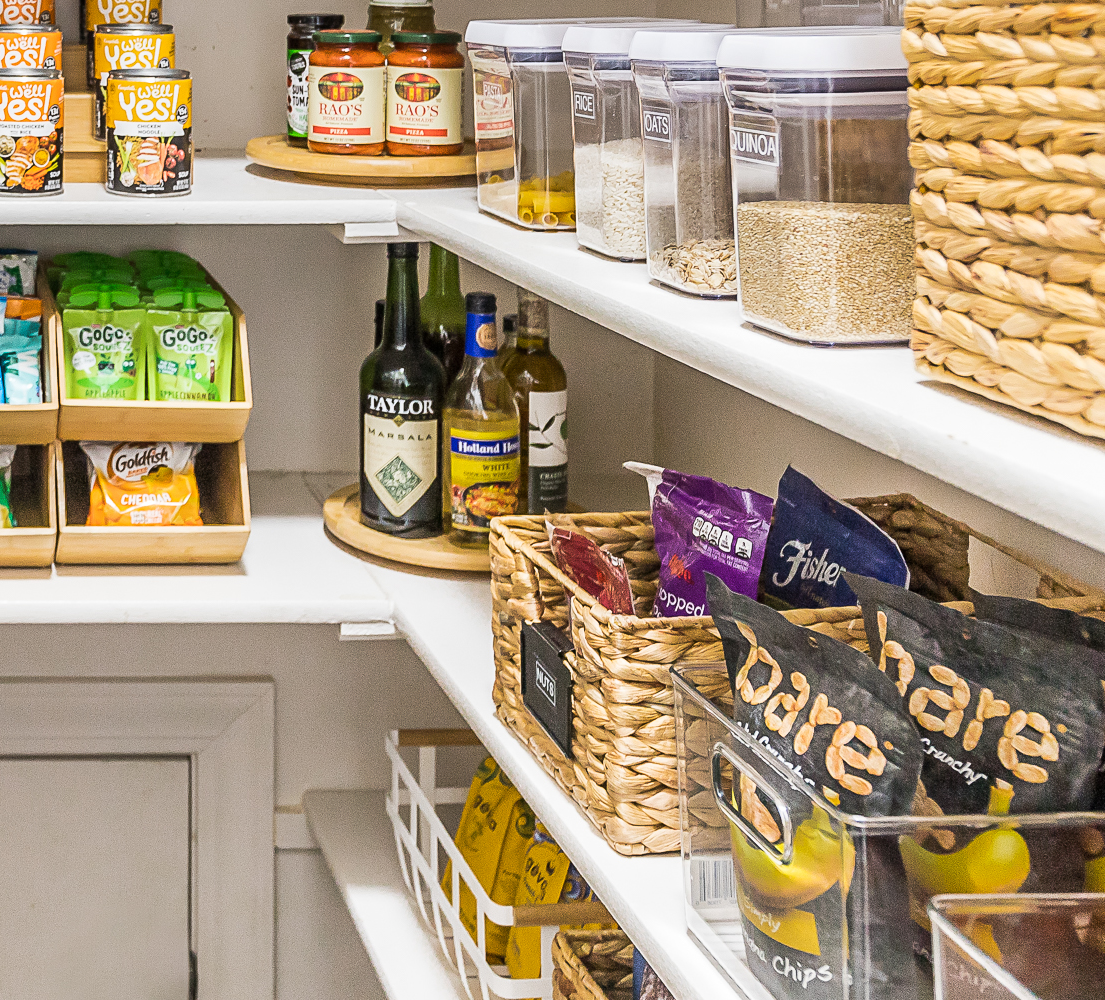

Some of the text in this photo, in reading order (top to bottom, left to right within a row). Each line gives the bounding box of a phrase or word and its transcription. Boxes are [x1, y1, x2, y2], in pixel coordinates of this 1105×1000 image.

[6, 36, 40, 51] well
[121, 37, 156, 52] well
[104, 38, 162, 69] Yes!
[9, 84, 45, 99] well
[137, 84, 173, 99] well
[483, 84, 502, 100] PASTA
[118, 83, 180, 121] Yes!
[318, 102, 363, 117] RAO'S
[395, 102, 439, 118] RAO'S
[575, 94, 594, 112] RICE
[645, 115, 669, 135] OATS
[731, 131, 777, 158] QUINOA
[49, 171, 61, 179] SOUP
[178, 171, 190, 179] SOUP
[79, 326, 124, 347] GoGo
[162, 327, 208, 348] GoGo
[367, 394, 434, 415] TAYLOR
[368, 427, 433, 441] MARSALA
[458, 441, 500, 454] Holland
[115, 446, 170, 473] Goldfish
[482, 463, 510, 471] WHITE
[120, 492, 172, 506] CHEDDAR
[772, 540, 847, 588] Fisher
[536, 667, 554, 697] NUTS
[877, 610, 1060, 784] bare
[734, 619, 887, 796] bare
[920, 738, 989, 786] Crunchy
[772, 955, 833, 989] Chips
